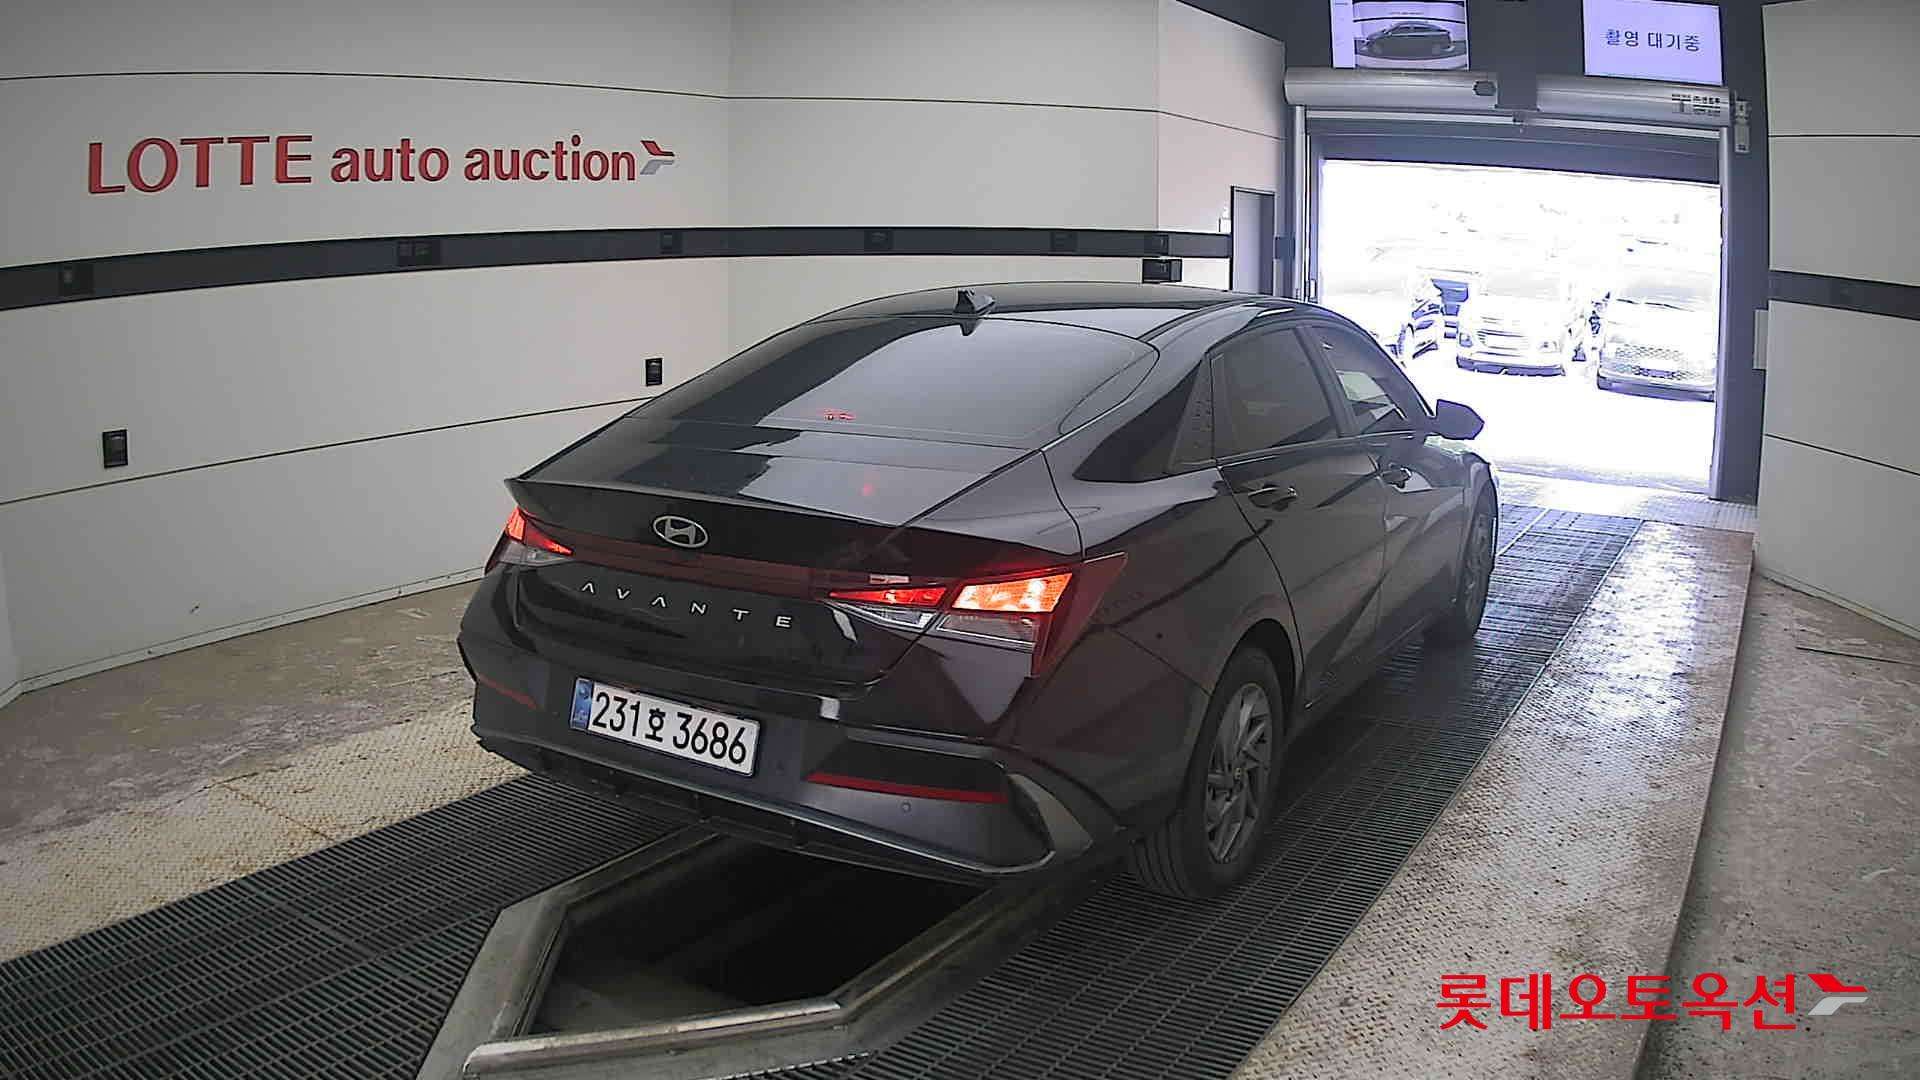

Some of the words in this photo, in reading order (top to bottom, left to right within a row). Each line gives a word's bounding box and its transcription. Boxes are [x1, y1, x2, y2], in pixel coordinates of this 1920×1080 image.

[1648, 32, 1700, 52] 대기중
[88, 135, 313, 194] LOTTE
[330, 138, 450, 183] auto
[463, 134, 636, 182] auction
[581, 581, 793, 629] AVANTE
[592, 691, 666, 743] 231호
[672, 711, 747, 765] 3686
